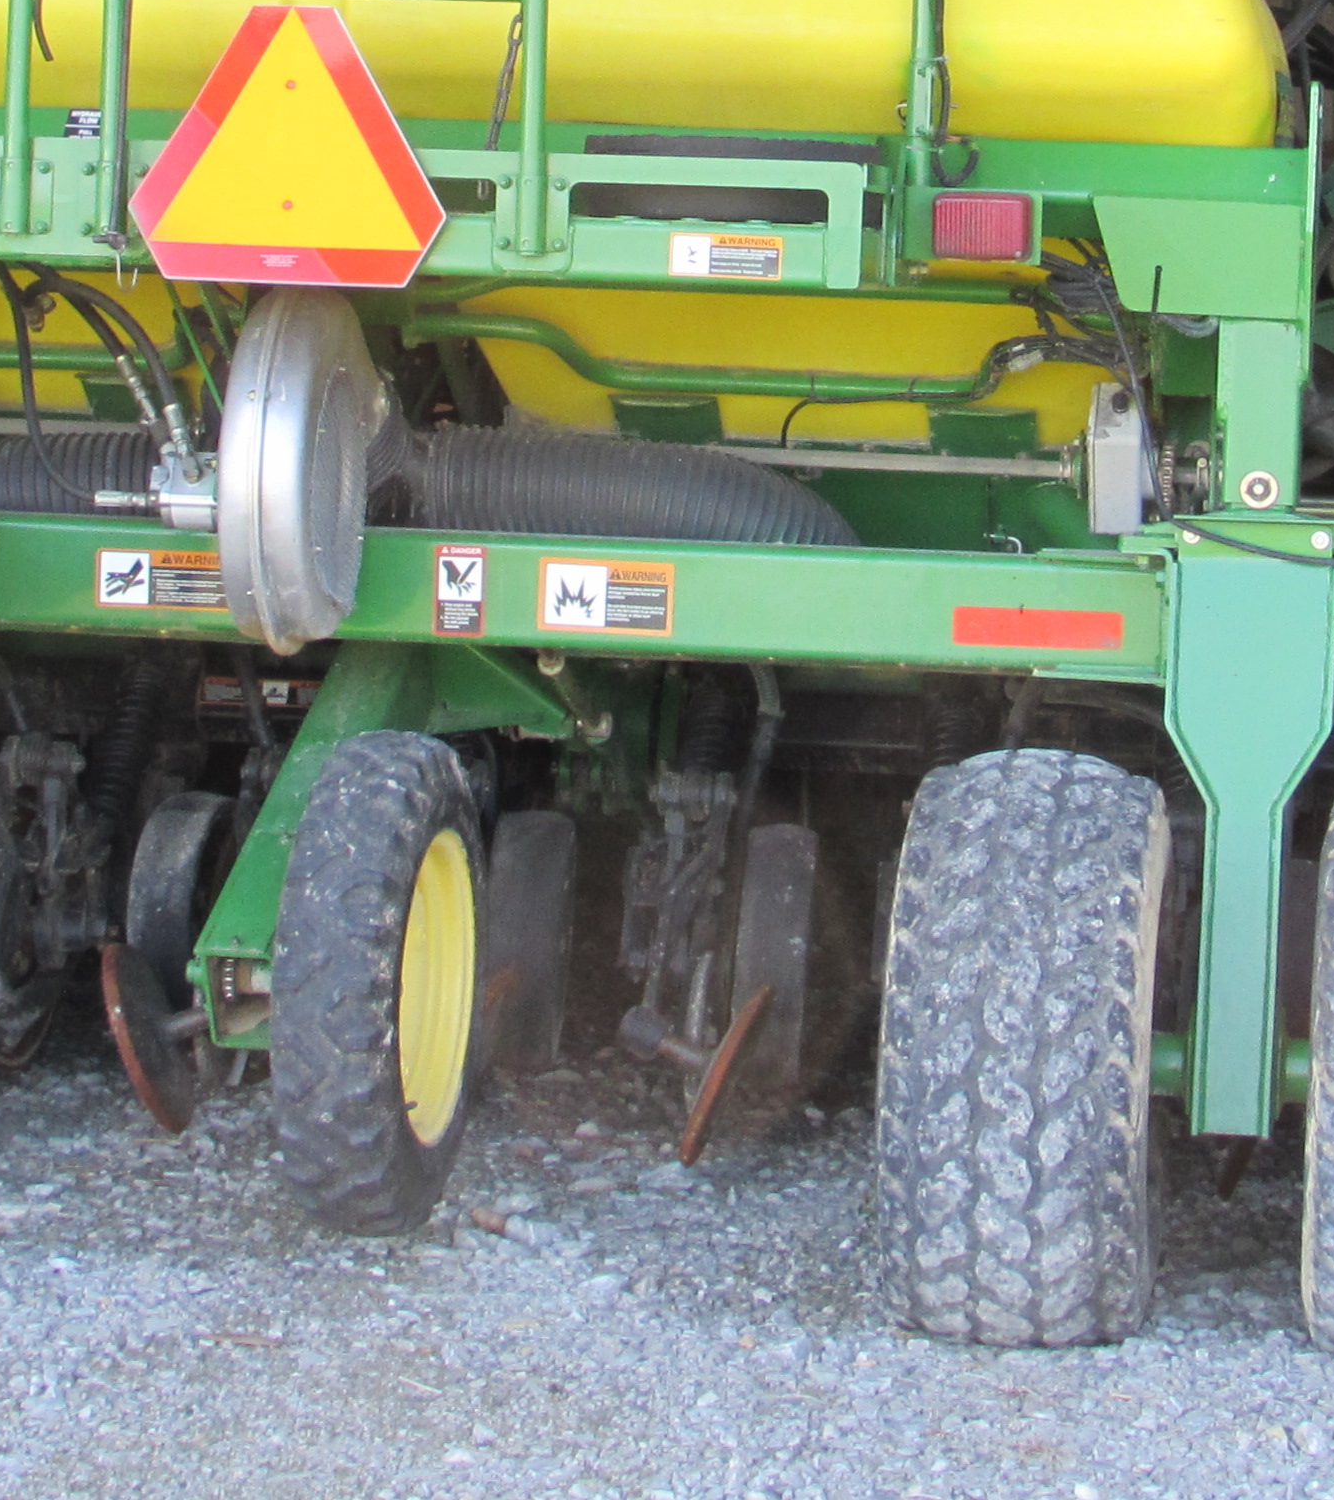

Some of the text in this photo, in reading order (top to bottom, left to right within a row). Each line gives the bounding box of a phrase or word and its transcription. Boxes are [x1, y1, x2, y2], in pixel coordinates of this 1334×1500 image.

[727, 237, 776, 247] WARNING
[450, 546, 482, 555] DANGER
[622, 570, 667, 583] WARNING
